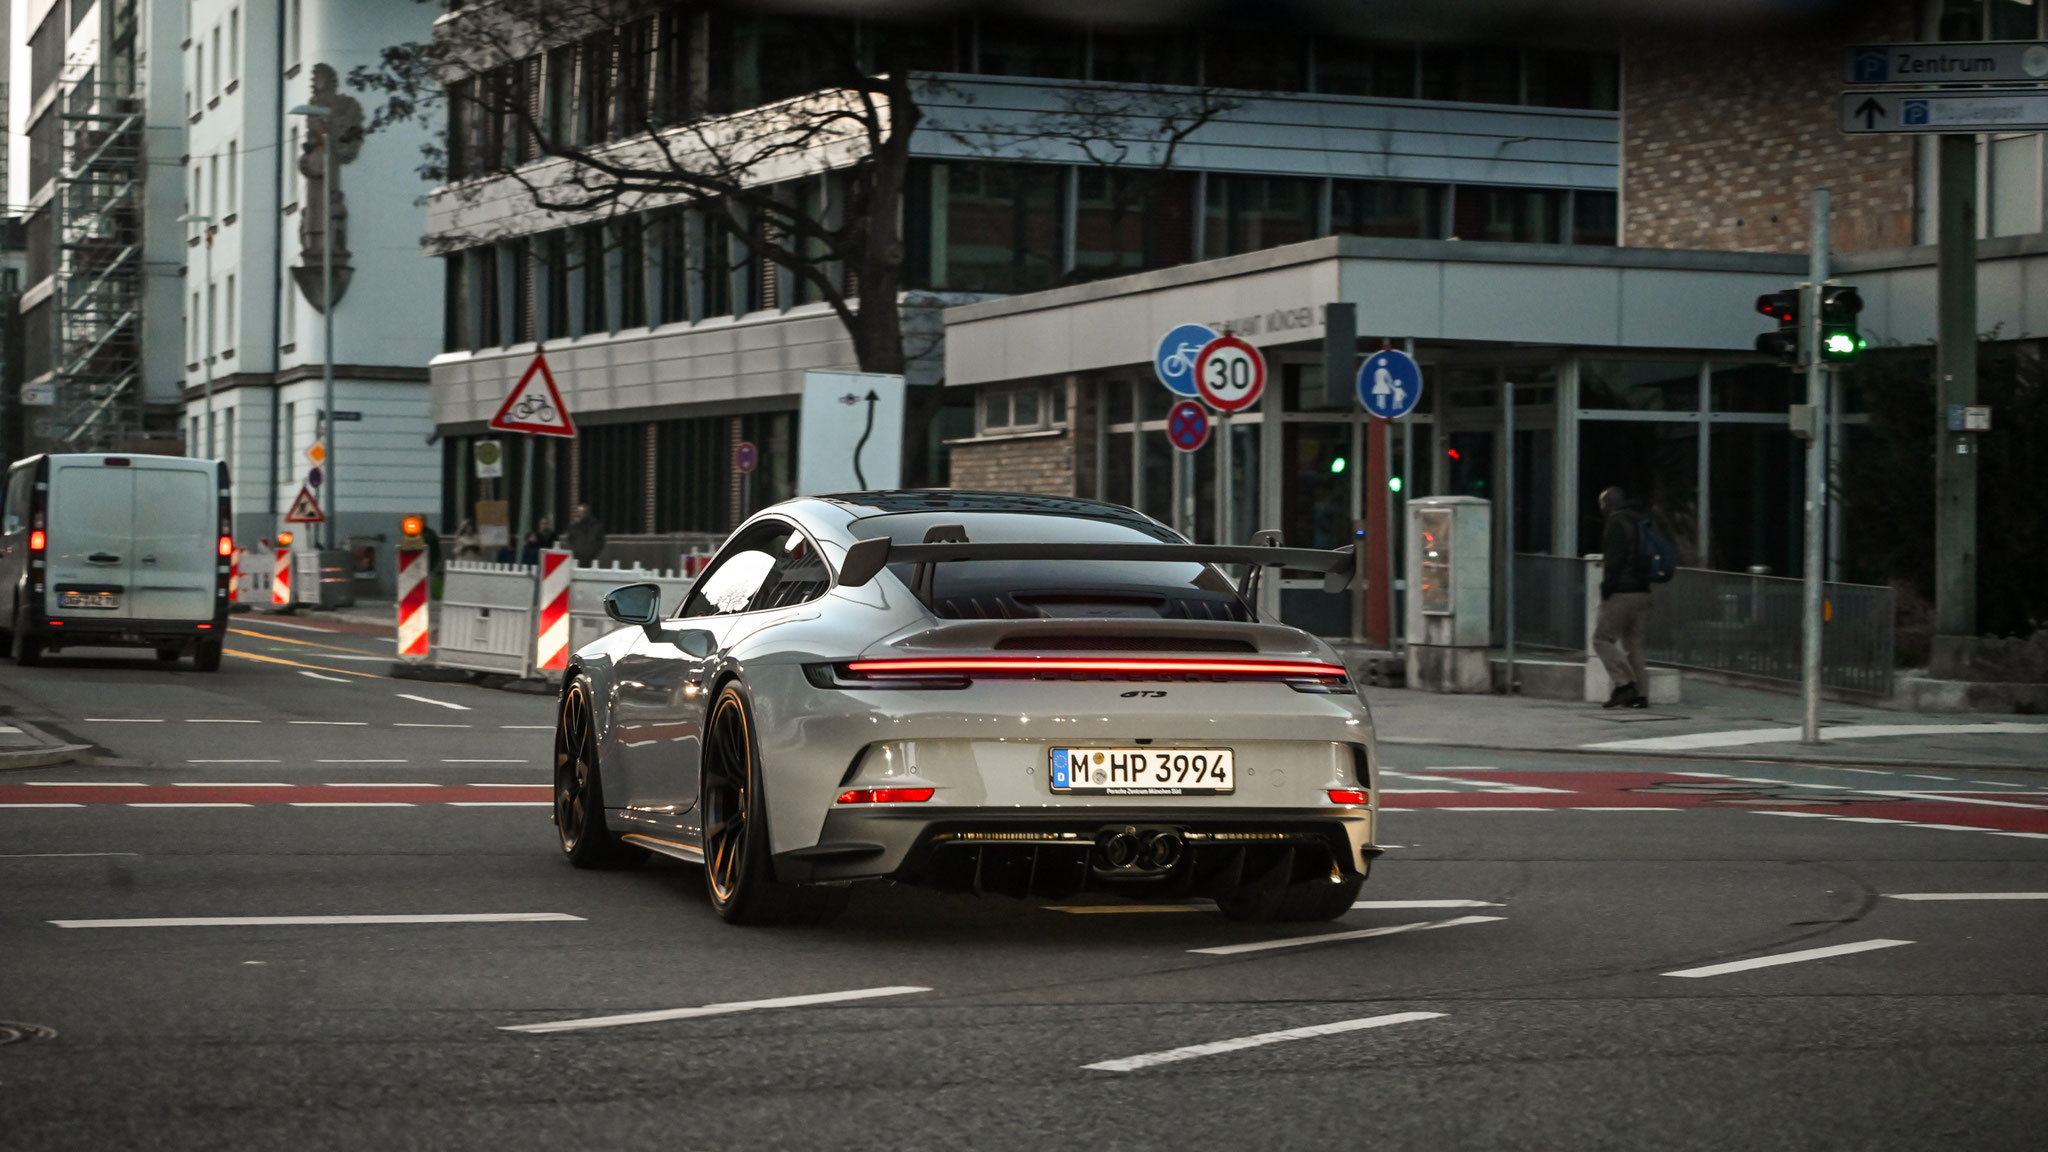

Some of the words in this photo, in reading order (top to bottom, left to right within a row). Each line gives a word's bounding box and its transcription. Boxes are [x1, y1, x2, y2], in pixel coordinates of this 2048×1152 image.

[1897, 54, 1996, 74] Zentrum
[1209, 357, 1249, 390] 30
[1120, 690, 1168, 698] GT3
[1057, 772, 1065, 782] D
[1071, 754, 1089, 782] M
[1110, 754, 1148, 782] HP
[1155, 754, 1226, 783] 3994
